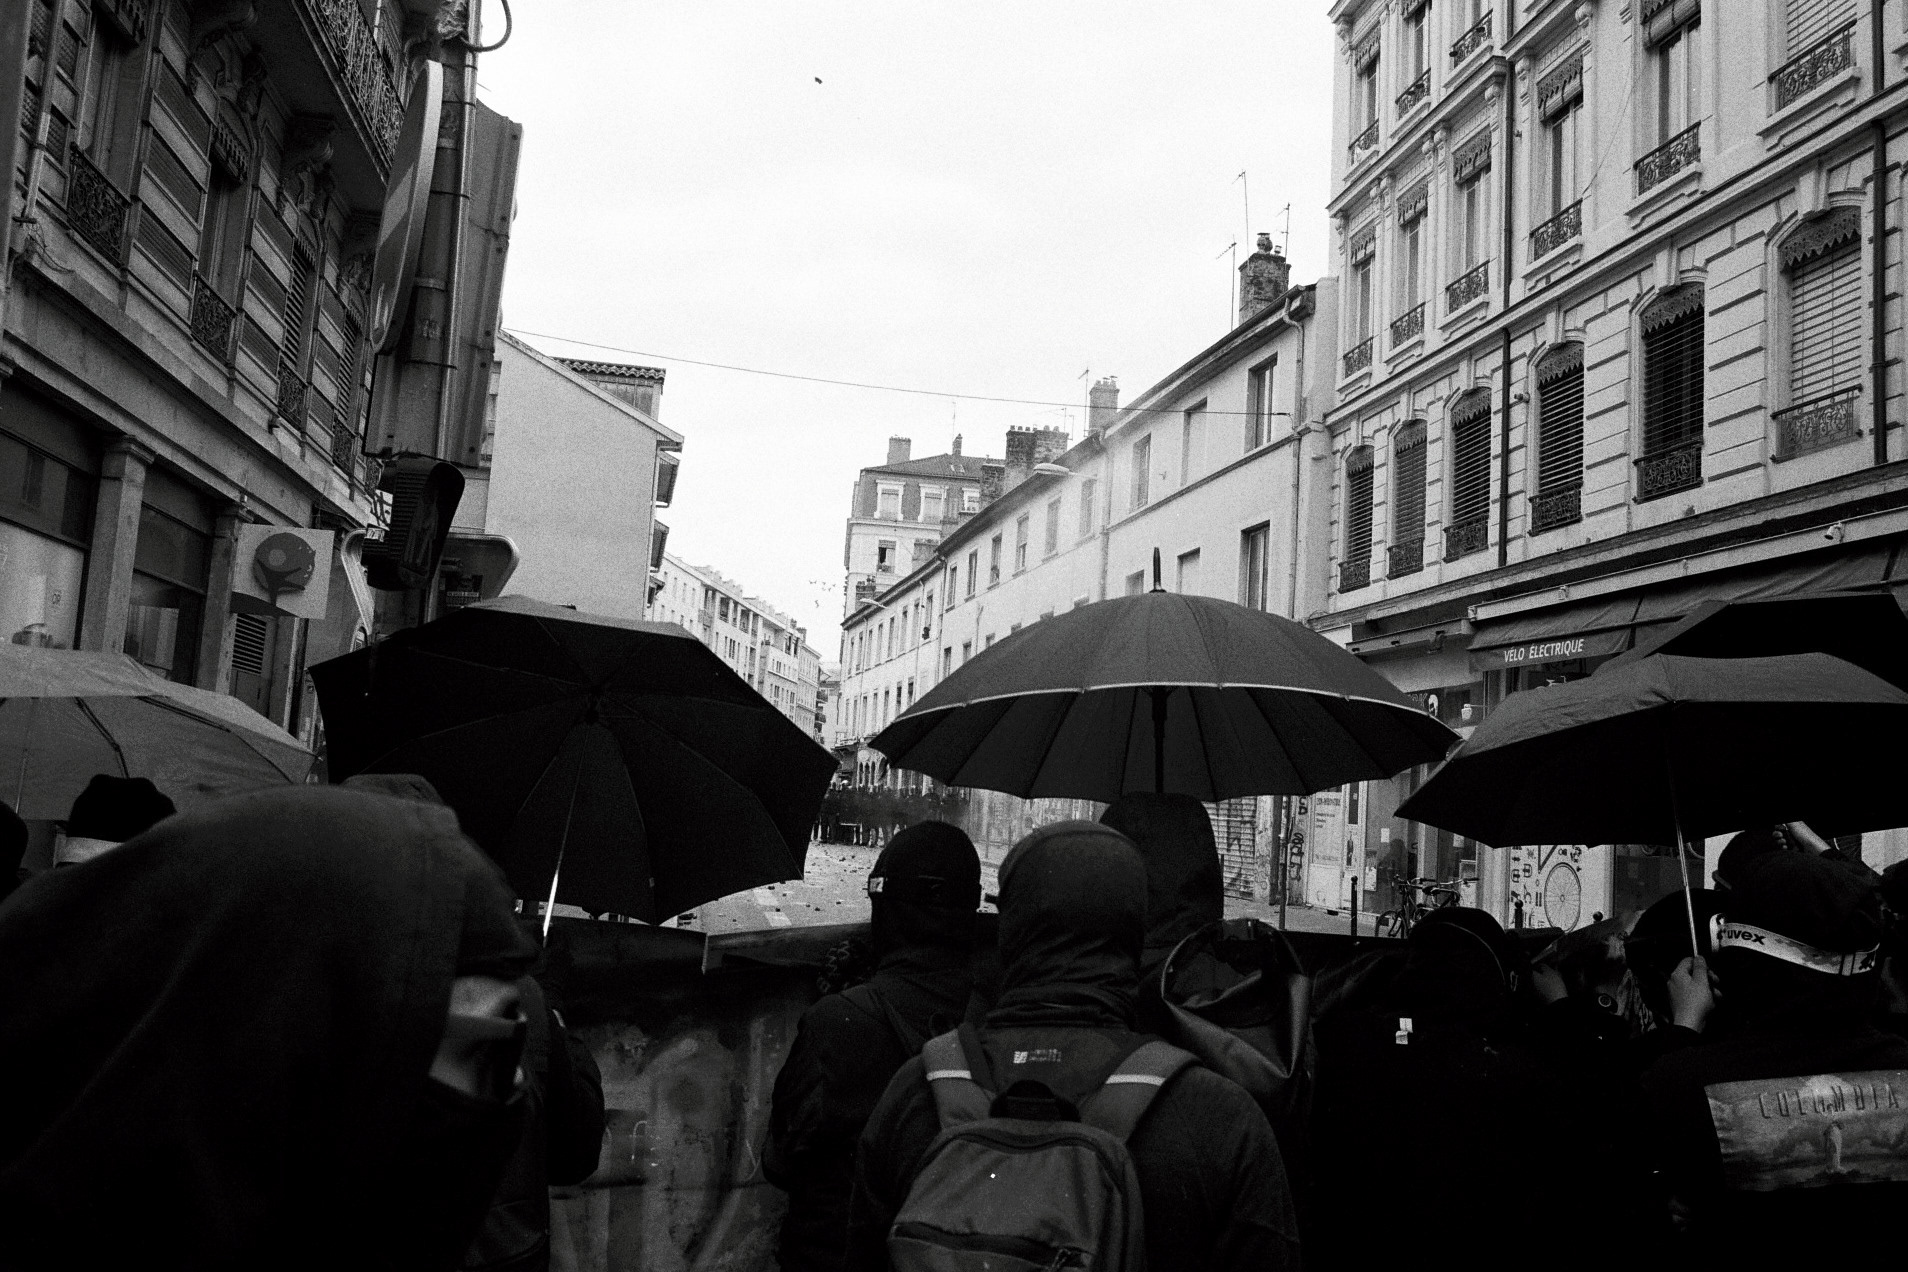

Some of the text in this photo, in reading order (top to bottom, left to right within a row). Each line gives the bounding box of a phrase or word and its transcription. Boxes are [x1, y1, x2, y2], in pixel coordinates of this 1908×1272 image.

[1504, 639, 1585, 662] VÉLO ÉLECTRIQUE
[1727, 929, 1766, 945] uvex
